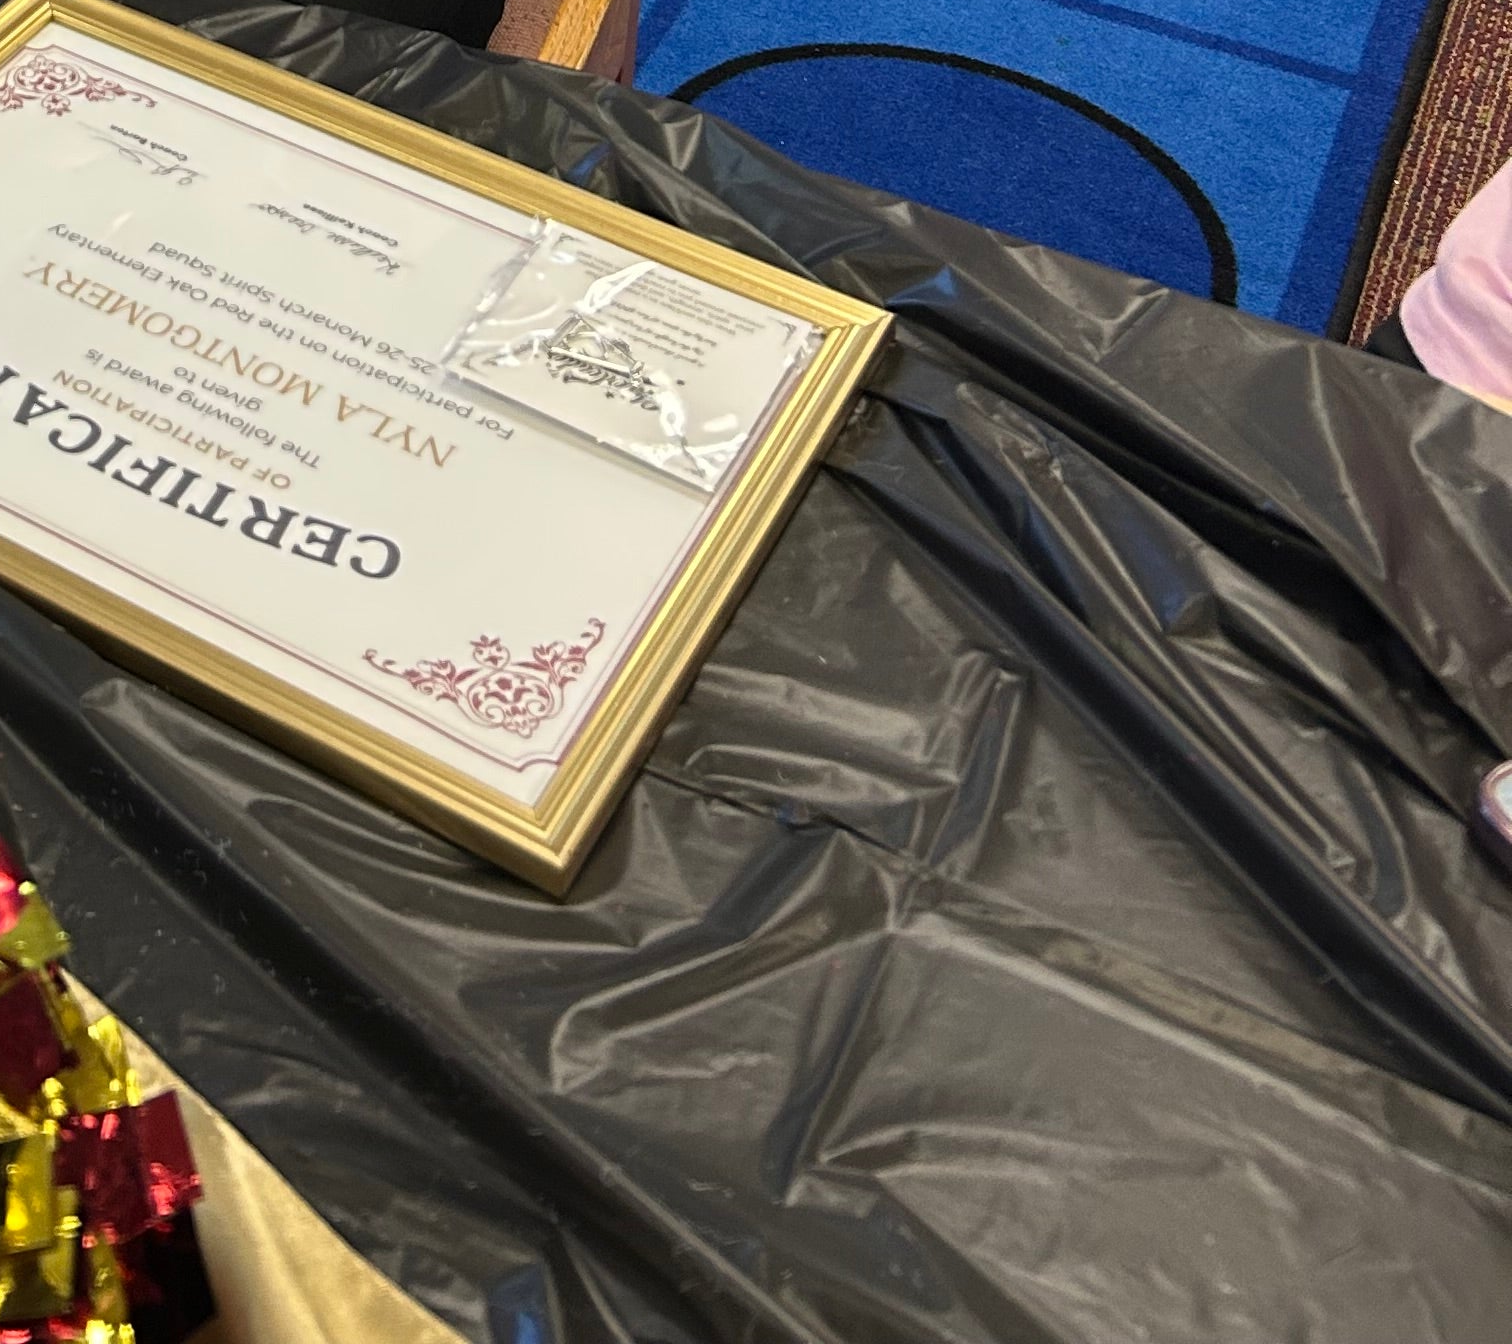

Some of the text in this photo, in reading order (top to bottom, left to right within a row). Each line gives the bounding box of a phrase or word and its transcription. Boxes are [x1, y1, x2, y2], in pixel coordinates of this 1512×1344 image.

[150, 141, 188, 162] Coach
[357, 225, 399, 248] Coach
[22, 260, 458, 468] NYLA MONTGOMERY
[46, 223, 516, 441] For participation on the Red Oak Elementary
[146, 240, 437, 375] 25-26 Monarch Spirit Squad
[52, 368, 292, 490] OF PARTICIPATION
[85, 347, 322, 470] The following award is
[173, 365, 265, 413] given to
